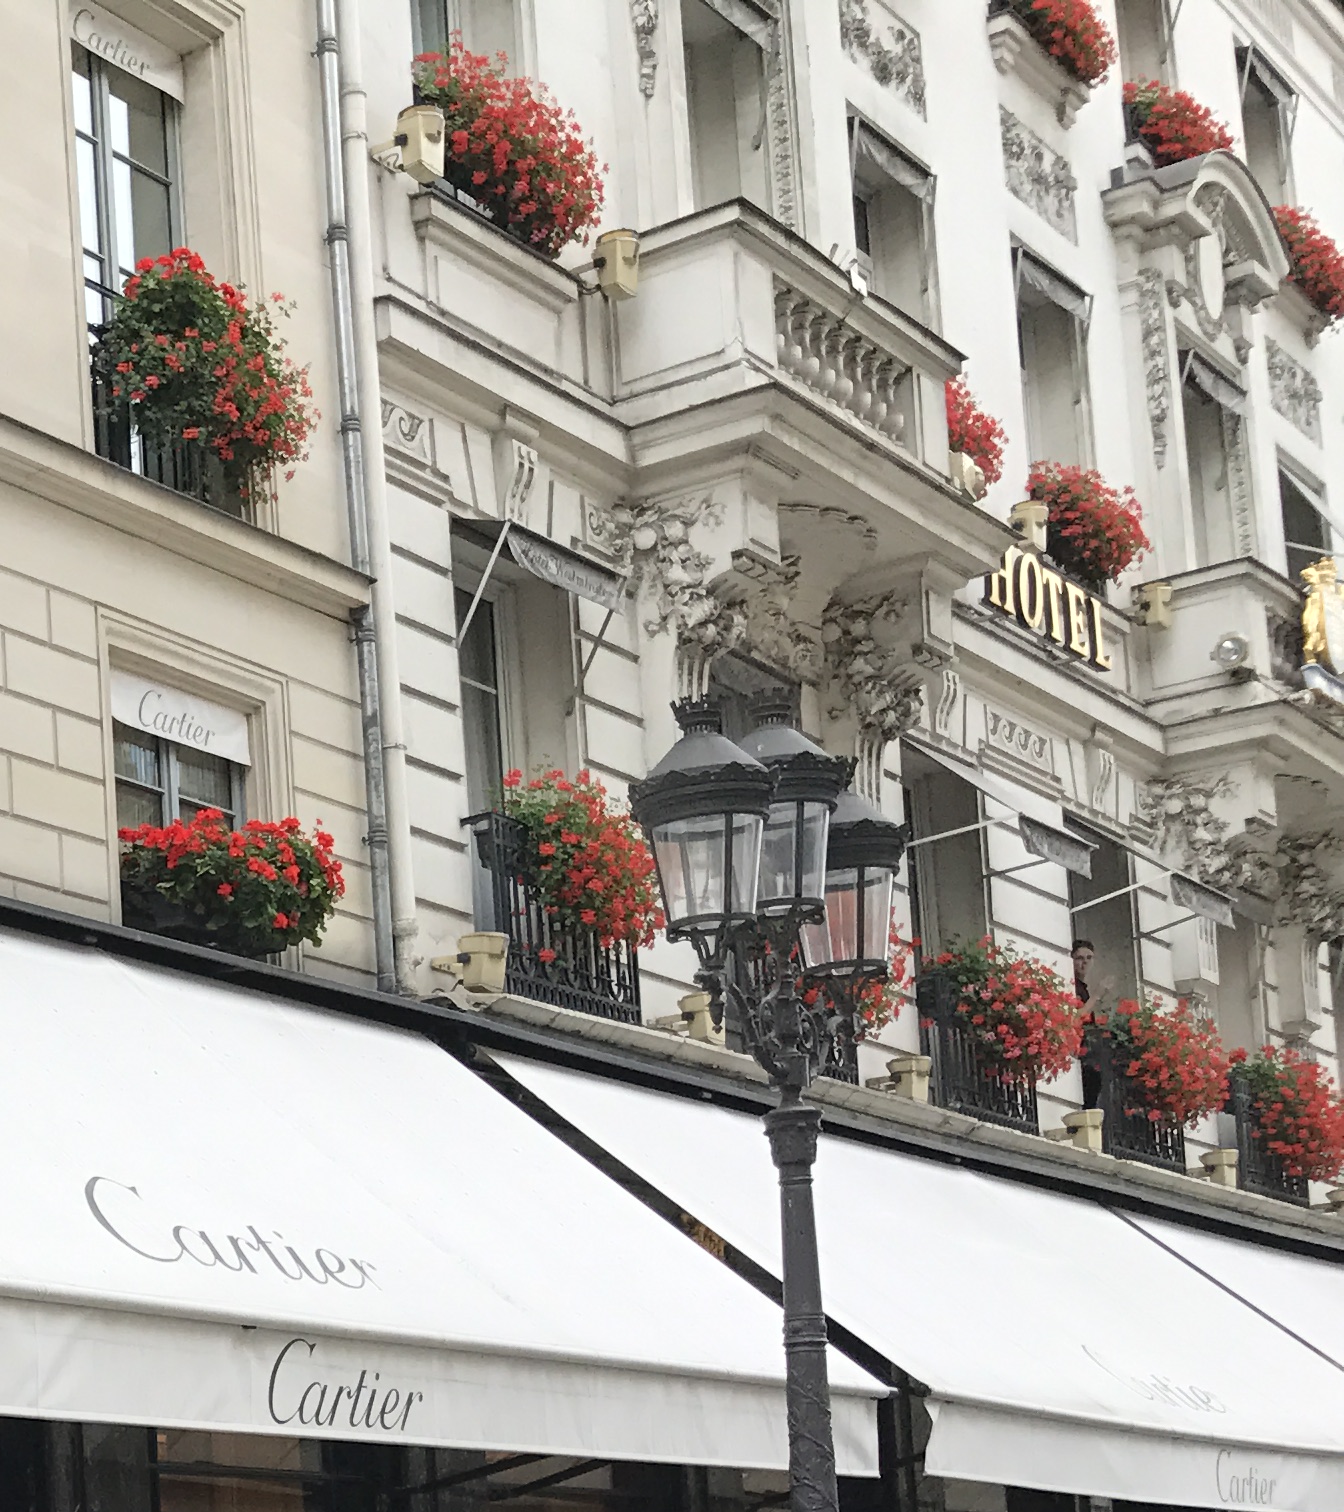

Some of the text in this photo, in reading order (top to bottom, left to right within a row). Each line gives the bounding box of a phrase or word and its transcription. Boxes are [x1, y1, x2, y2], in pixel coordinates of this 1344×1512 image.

[72, 8, 151, 76] Cartier
[988, 544, 1112, 672] HOTEL
[138, 689, 216, 747] Cartier
[84, 1175, 382, 1291] Cartier
[268, 1337, 423, 1431] Cartier
[1216, 1448, 1277, 1505] Cartier
